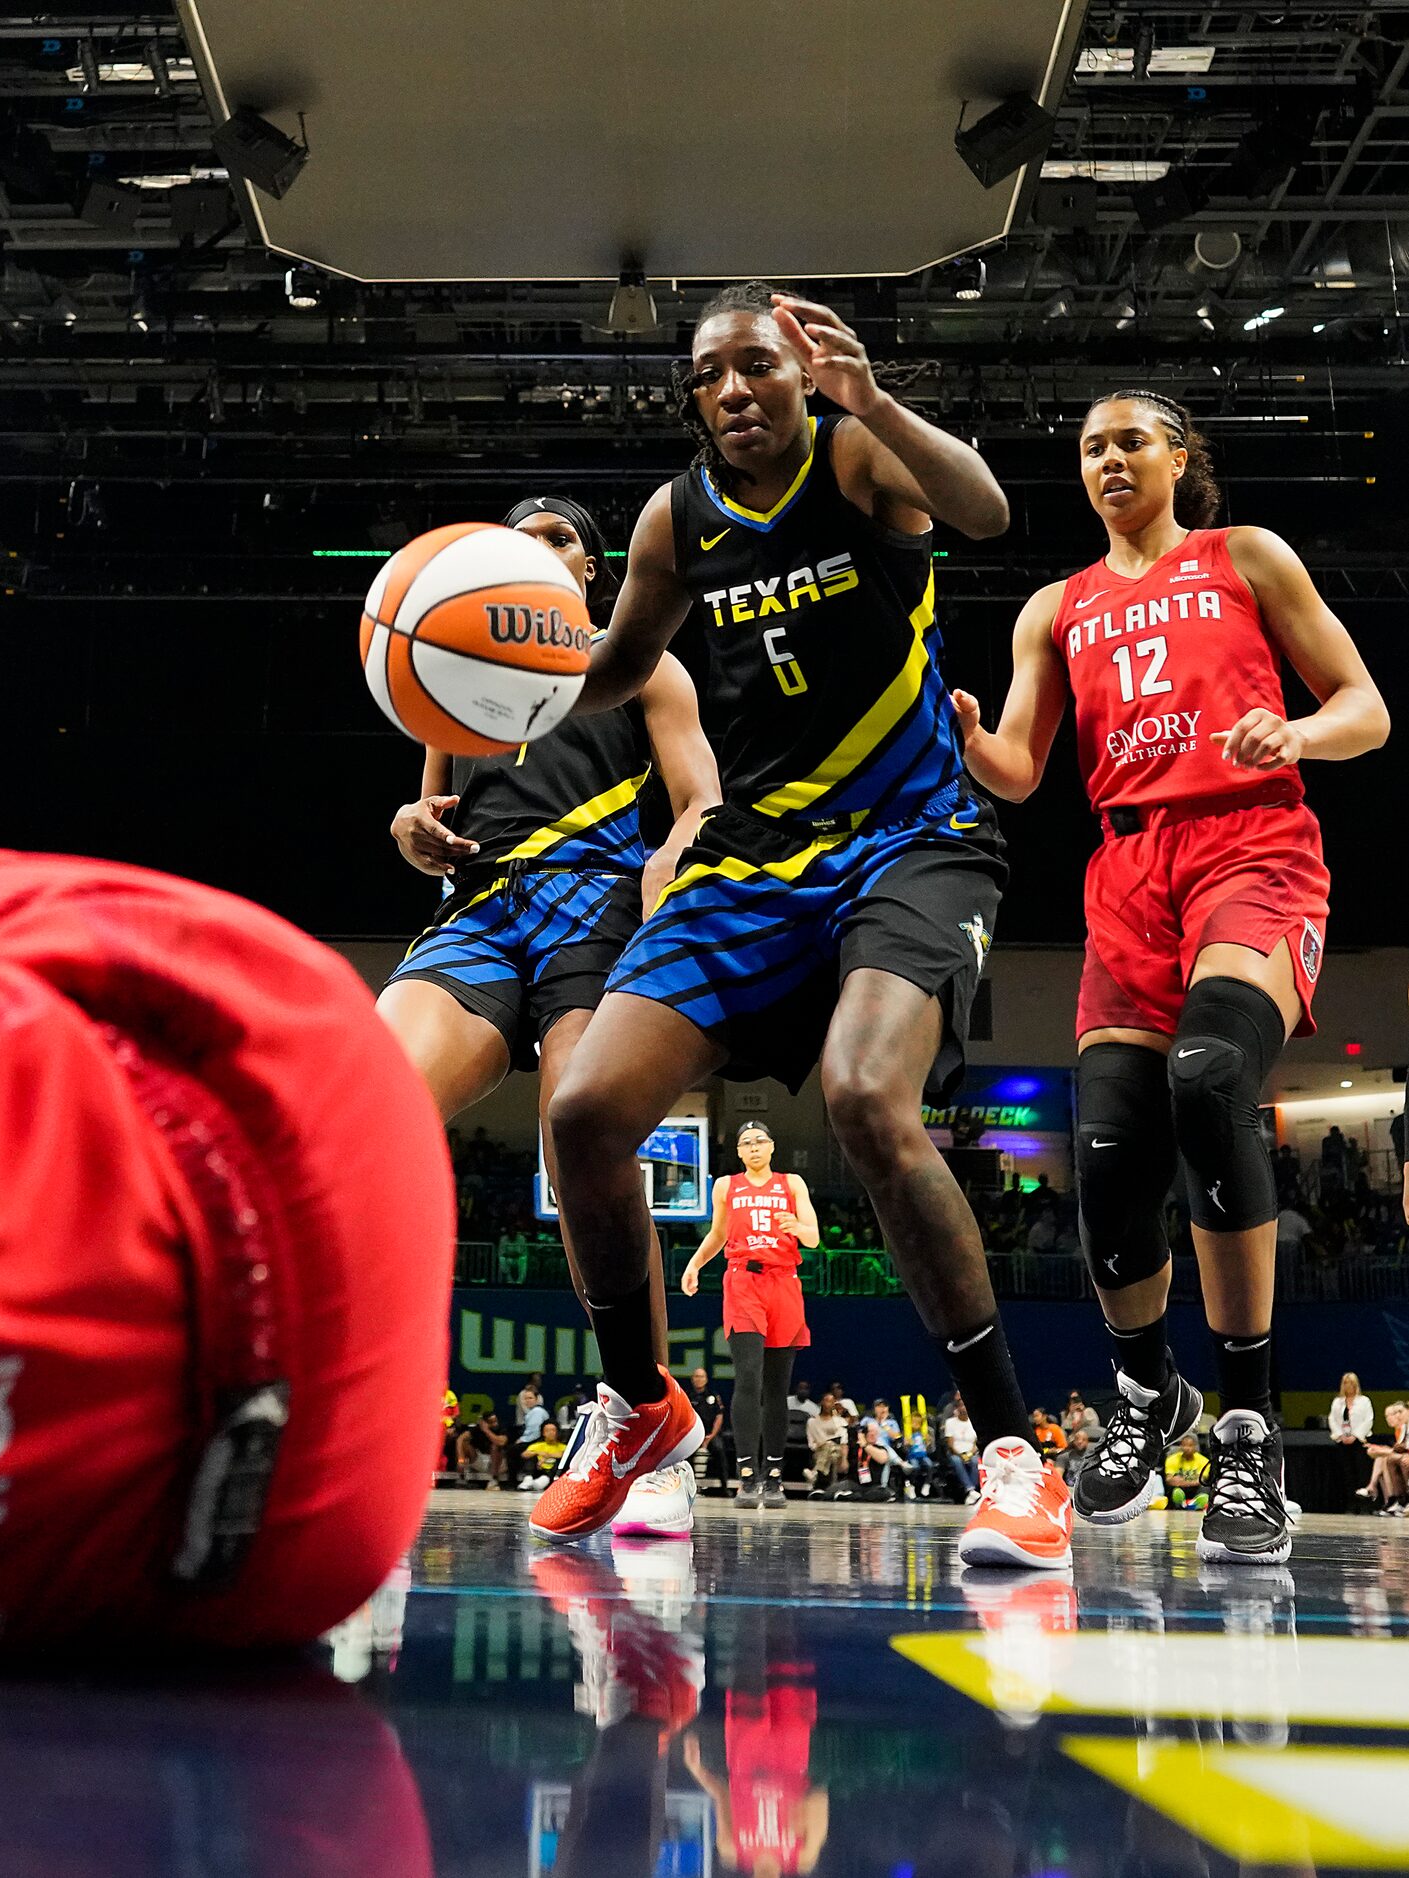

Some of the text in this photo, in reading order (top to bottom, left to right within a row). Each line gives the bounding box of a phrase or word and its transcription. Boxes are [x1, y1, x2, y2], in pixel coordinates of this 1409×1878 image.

[703, 552, 859, 627] TEXAS
[1169, 572, 1211, 584] Microsoft
[1067, 590, 1221, 659] ATLANTA
[763, 626, 808, 696] 6
[1112, 635, 1173, 703] 12
[732, 1195, 788, 1210] ATLANTA
[750, 1209, 772, 1232] 15
